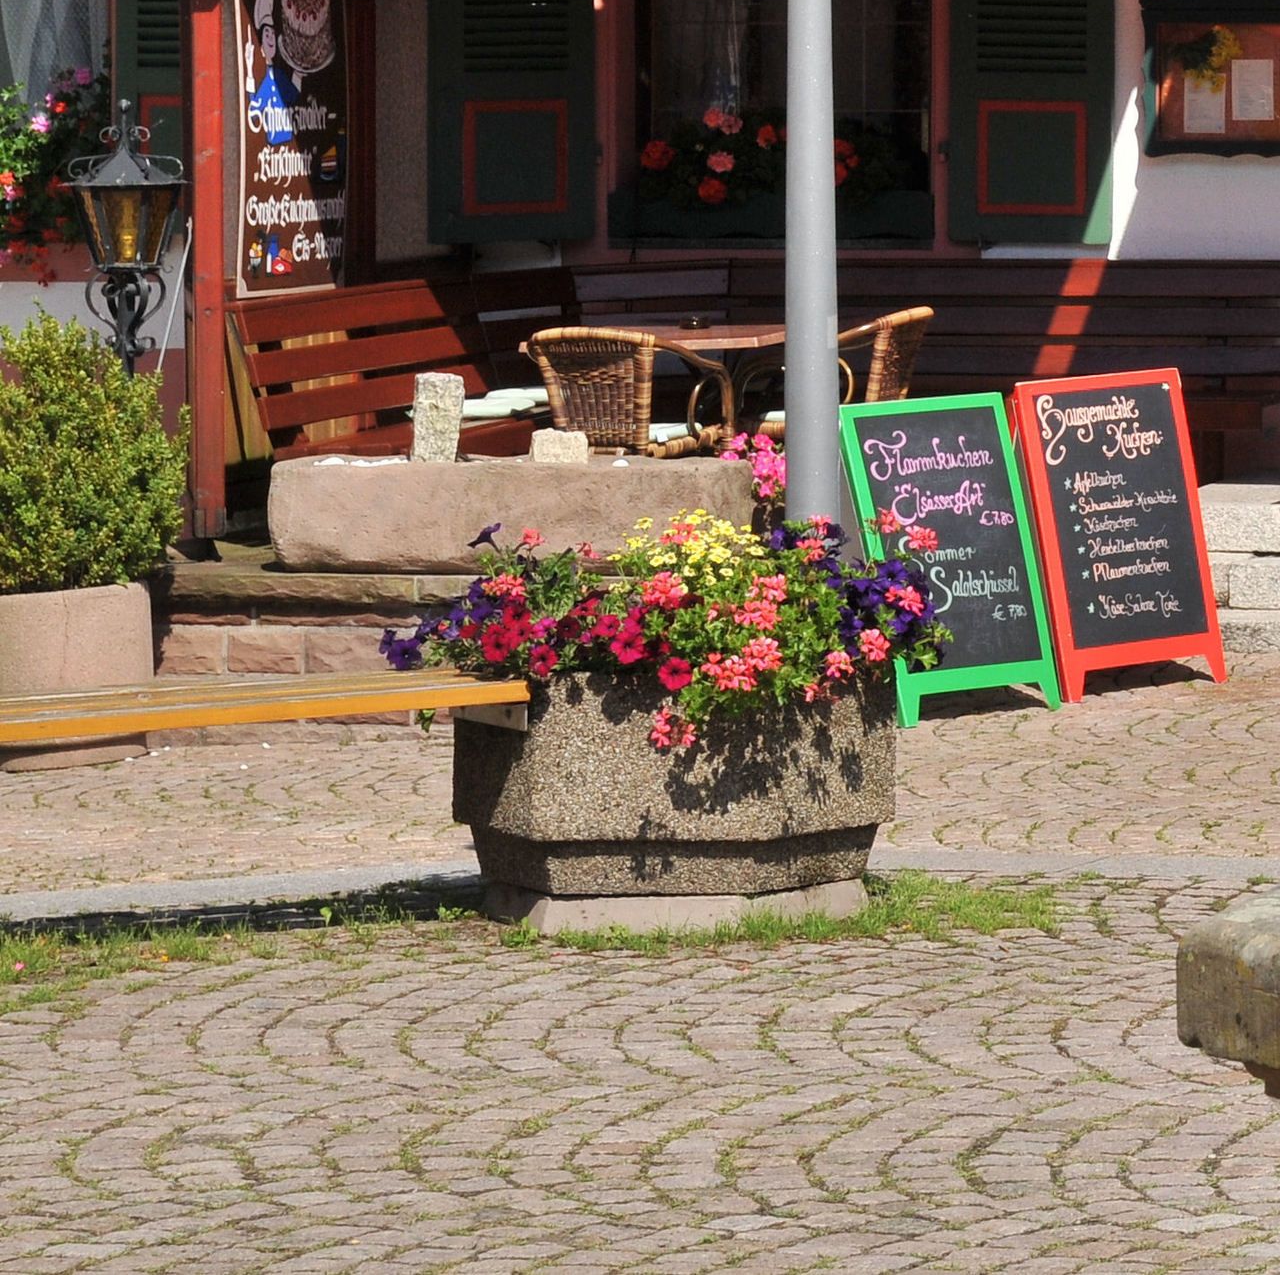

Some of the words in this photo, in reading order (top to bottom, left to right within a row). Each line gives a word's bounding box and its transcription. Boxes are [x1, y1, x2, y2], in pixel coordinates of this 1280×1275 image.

[1036, 394, 1140, 466] Hausgemachte
[863, 430, 994, 482] Flammkuchen
[930, 566, 1019, 615] Salatschüssel
[1092, 556, 1172, 583] Pflaumenkuchen
